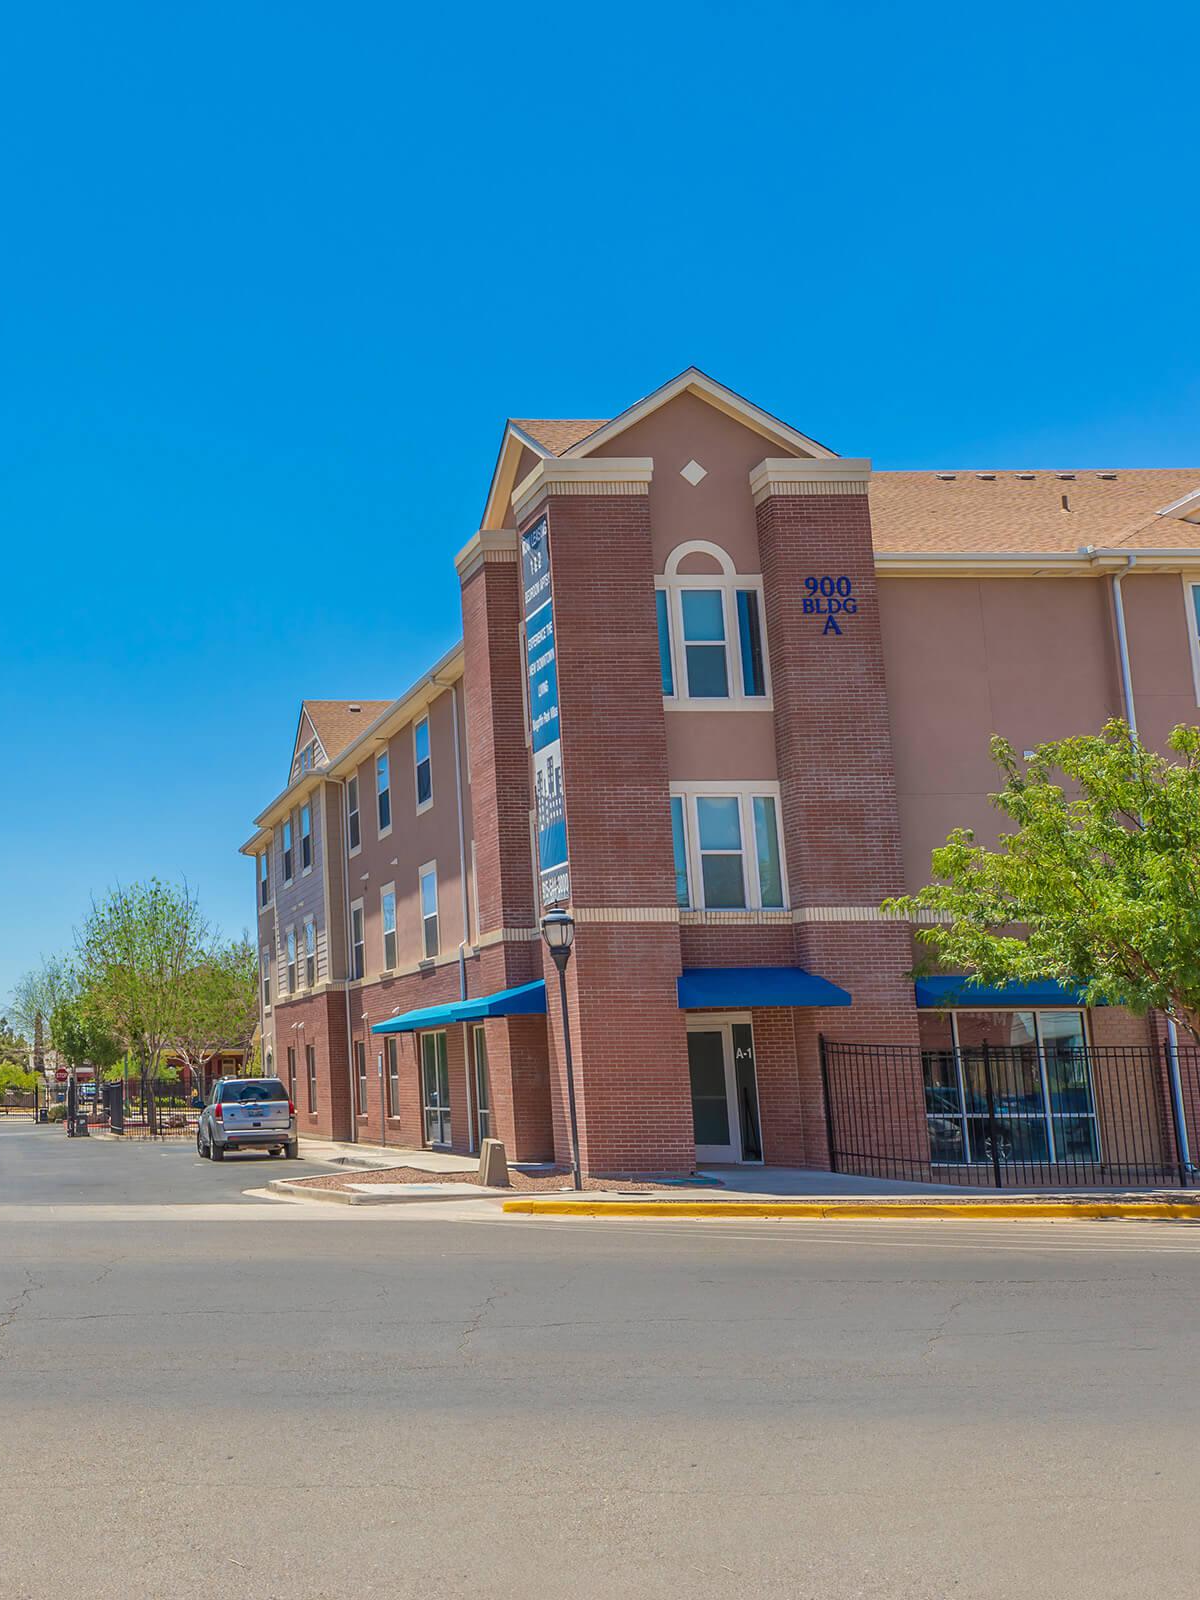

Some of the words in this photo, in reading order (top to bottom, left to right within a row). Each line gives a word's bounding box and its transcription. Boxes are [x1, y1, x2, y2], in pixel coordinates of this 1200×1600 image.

[804, 576, 852, 597] 900
[802, 598, 857, 614] BLDG
[822, 614, 843, 635] A
[736, 1047, 752, 1059] A-1
